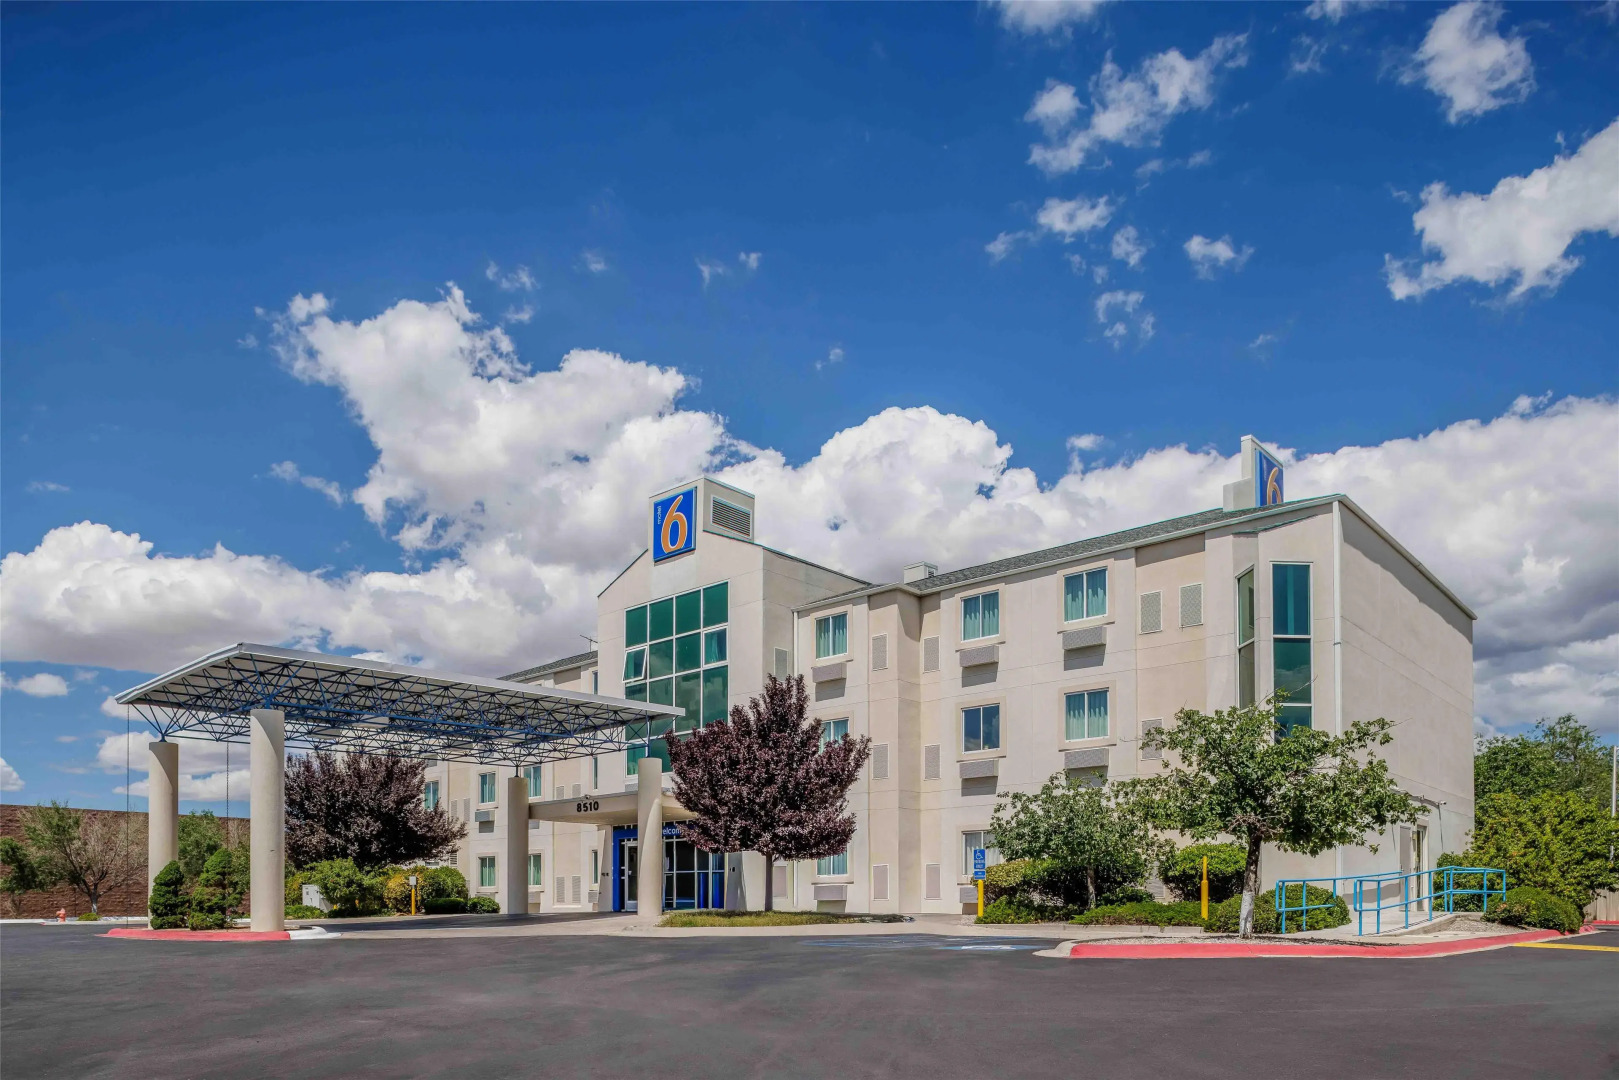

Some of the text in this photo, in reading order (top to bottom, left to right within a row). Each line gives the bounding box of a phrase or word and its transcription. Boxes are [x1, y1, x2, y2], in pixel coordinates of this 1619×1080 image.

[661, 494, 688, 554] 6
[576, 801, 599, 813] 8510
[662, 827, 682, 835] elcom
